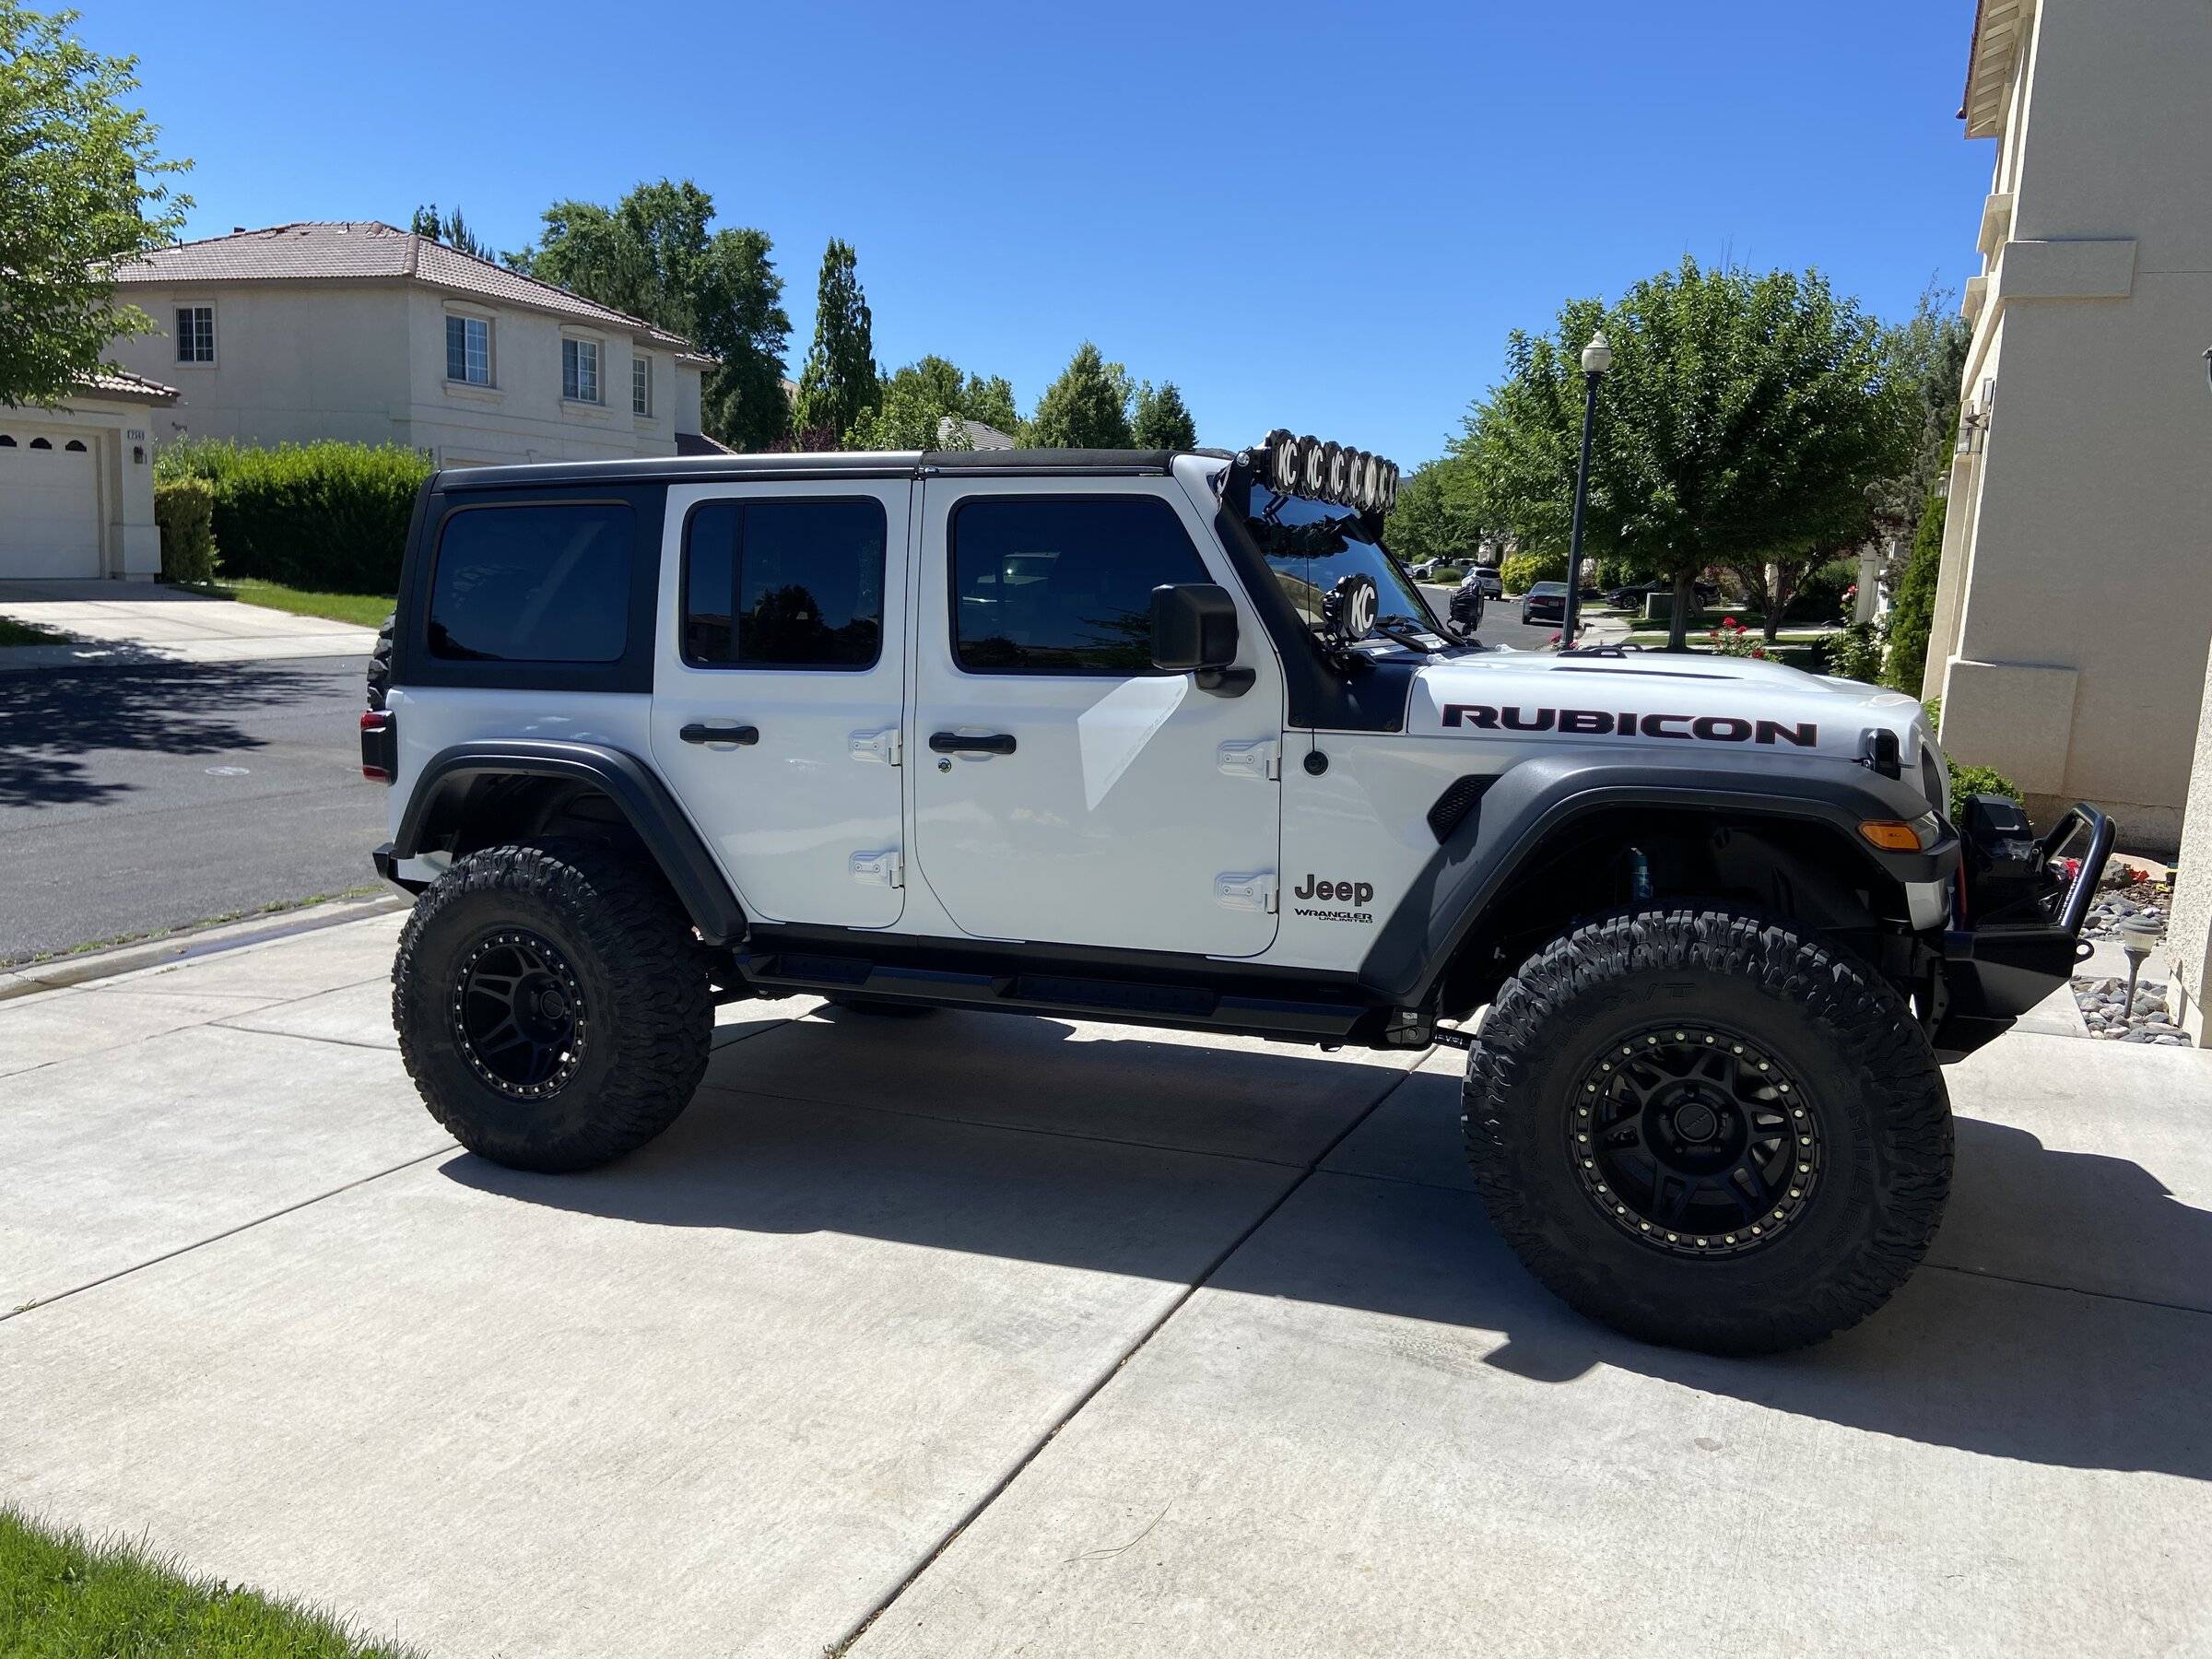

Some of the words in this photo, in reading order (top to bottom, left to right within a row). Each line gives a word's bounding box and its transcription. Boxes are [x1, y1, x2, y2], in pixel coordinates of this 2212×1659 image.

[1278, 439, 1298, 487] KC
[1307, 444, 1324, 491] KC
[1330, 451, 1345, 496] KC
[1349, 455, 1361, 499] KC
[1365, 460, 1376, 501] KC
[1351, 583, 1375, 632] KC
[1441, 703, 1818, 747] RUBICON
[1294, 874, 1374, 907] Jeep
[1294, 908, 1372, 920] WRANGLER
[1318, 916, 1373, 924] UNLIMITED
